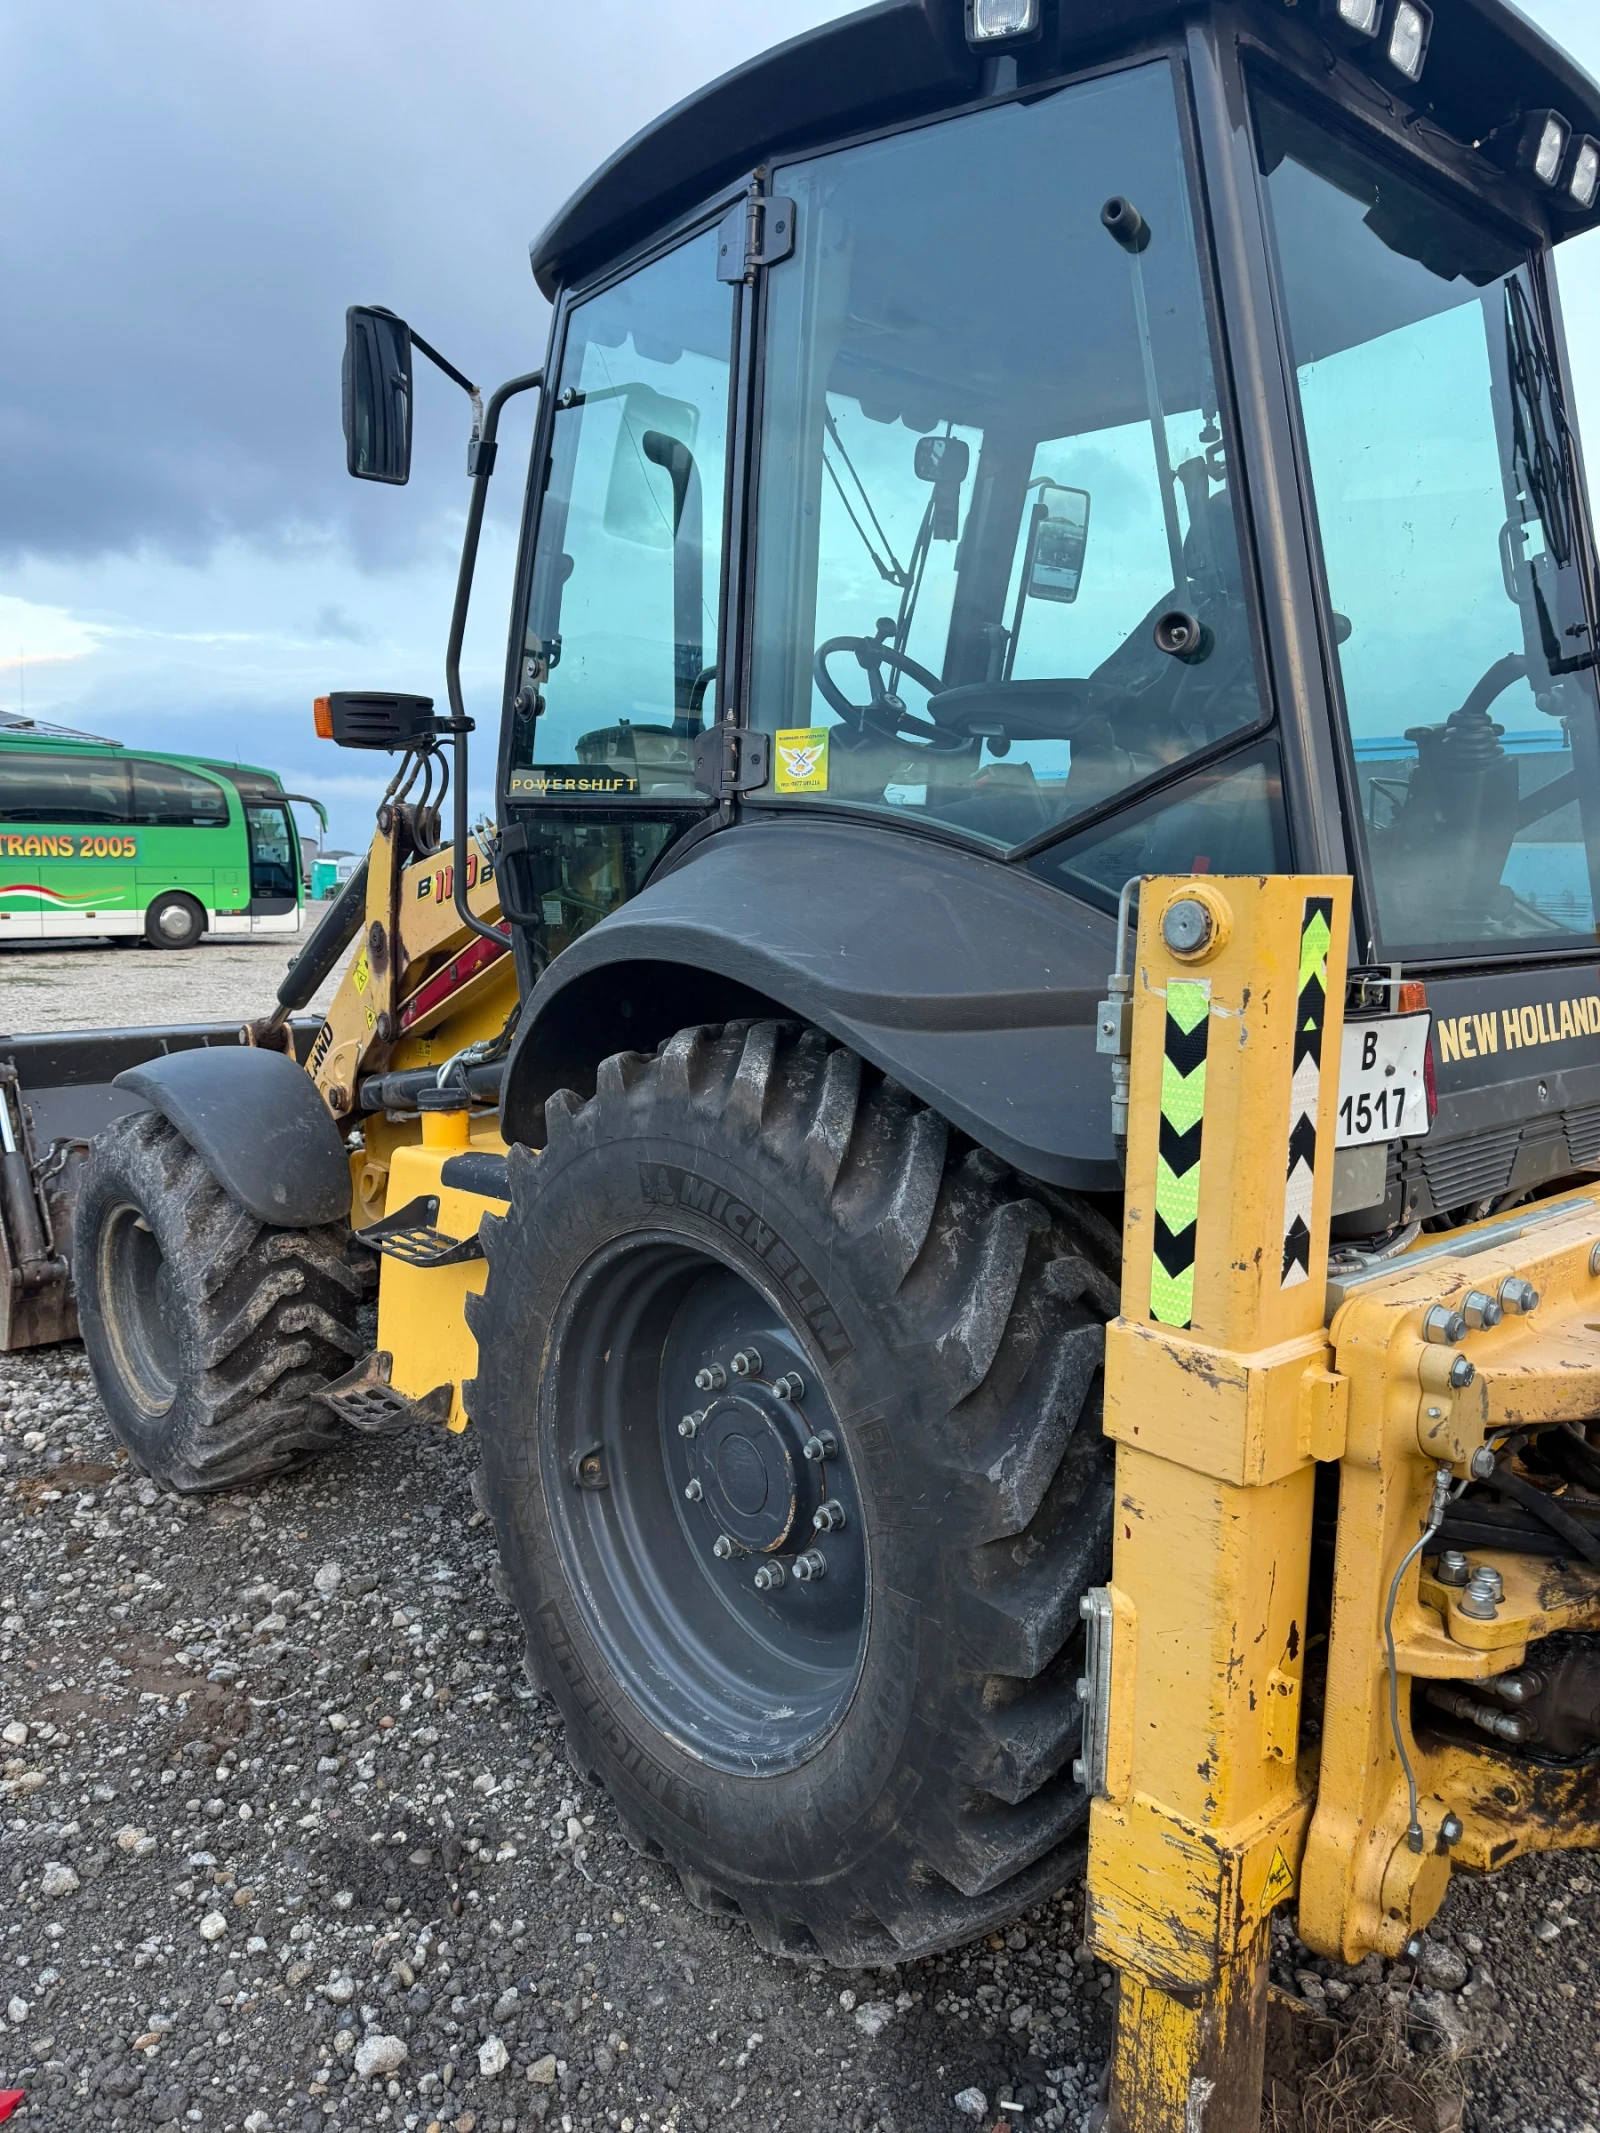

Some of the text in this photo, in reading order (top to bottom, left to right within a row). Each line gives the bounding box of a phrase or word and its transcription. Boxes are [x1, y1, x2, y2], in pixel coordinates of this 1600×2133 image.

[511, 777, 638, 791] POWERSHIFT
[80, 836, 136, 857] 2005
[1361, 1031, 1378, 1071] B
[1437, 996, 1600, 1063] NEW HOLLAND
[1339, 1087, 1406, 1136] 1517
[680, 1174, 852, 1352] MICHELIN
